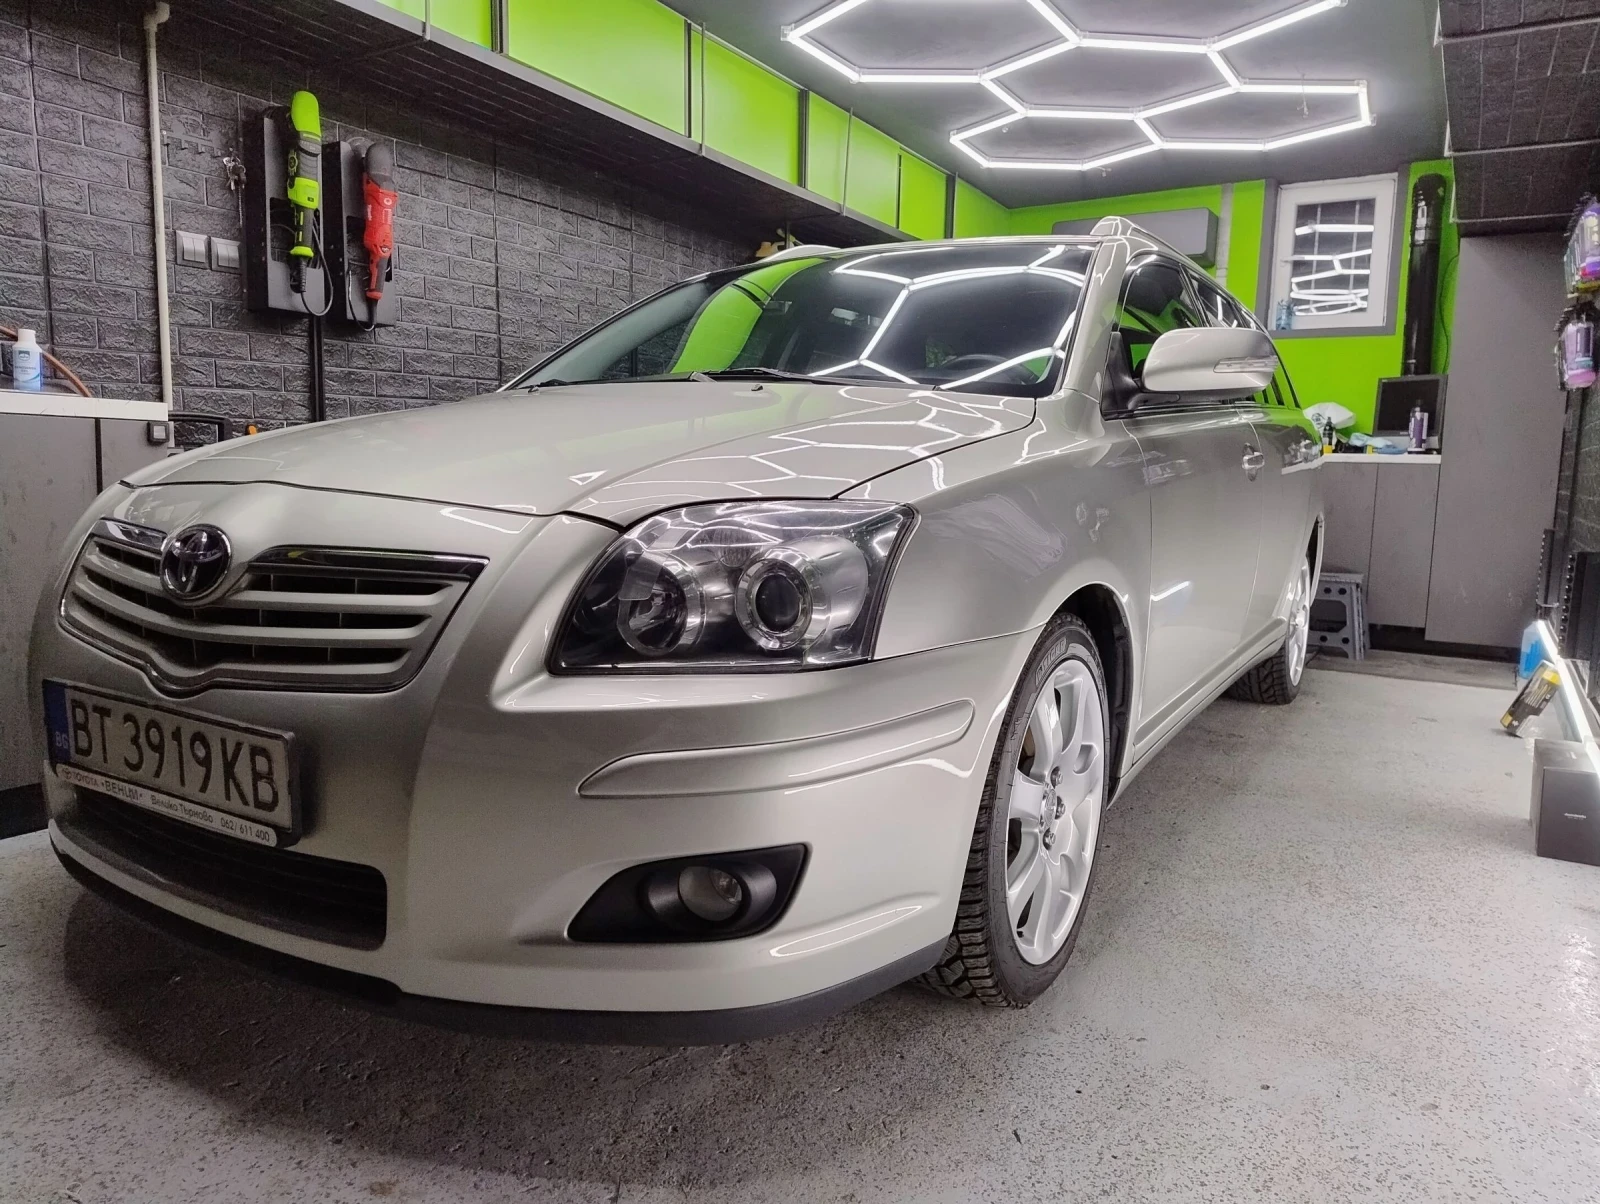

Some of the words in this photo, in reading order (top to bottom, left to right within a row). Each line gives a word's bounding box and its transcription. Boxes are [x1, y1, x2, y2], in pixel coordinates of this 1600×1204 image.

[55, 730, 69, 749] BG
[70, 698, 112, 764] BT
[123, 712, 213, 794] 3919
[220, 737, 279, 812] KB
[73, 771, 99, 787] TOYOTA
[179, 803, 213, 824] Търново
[240, 824, 253, 837] 611
[256, 829, 270, 843] 400
